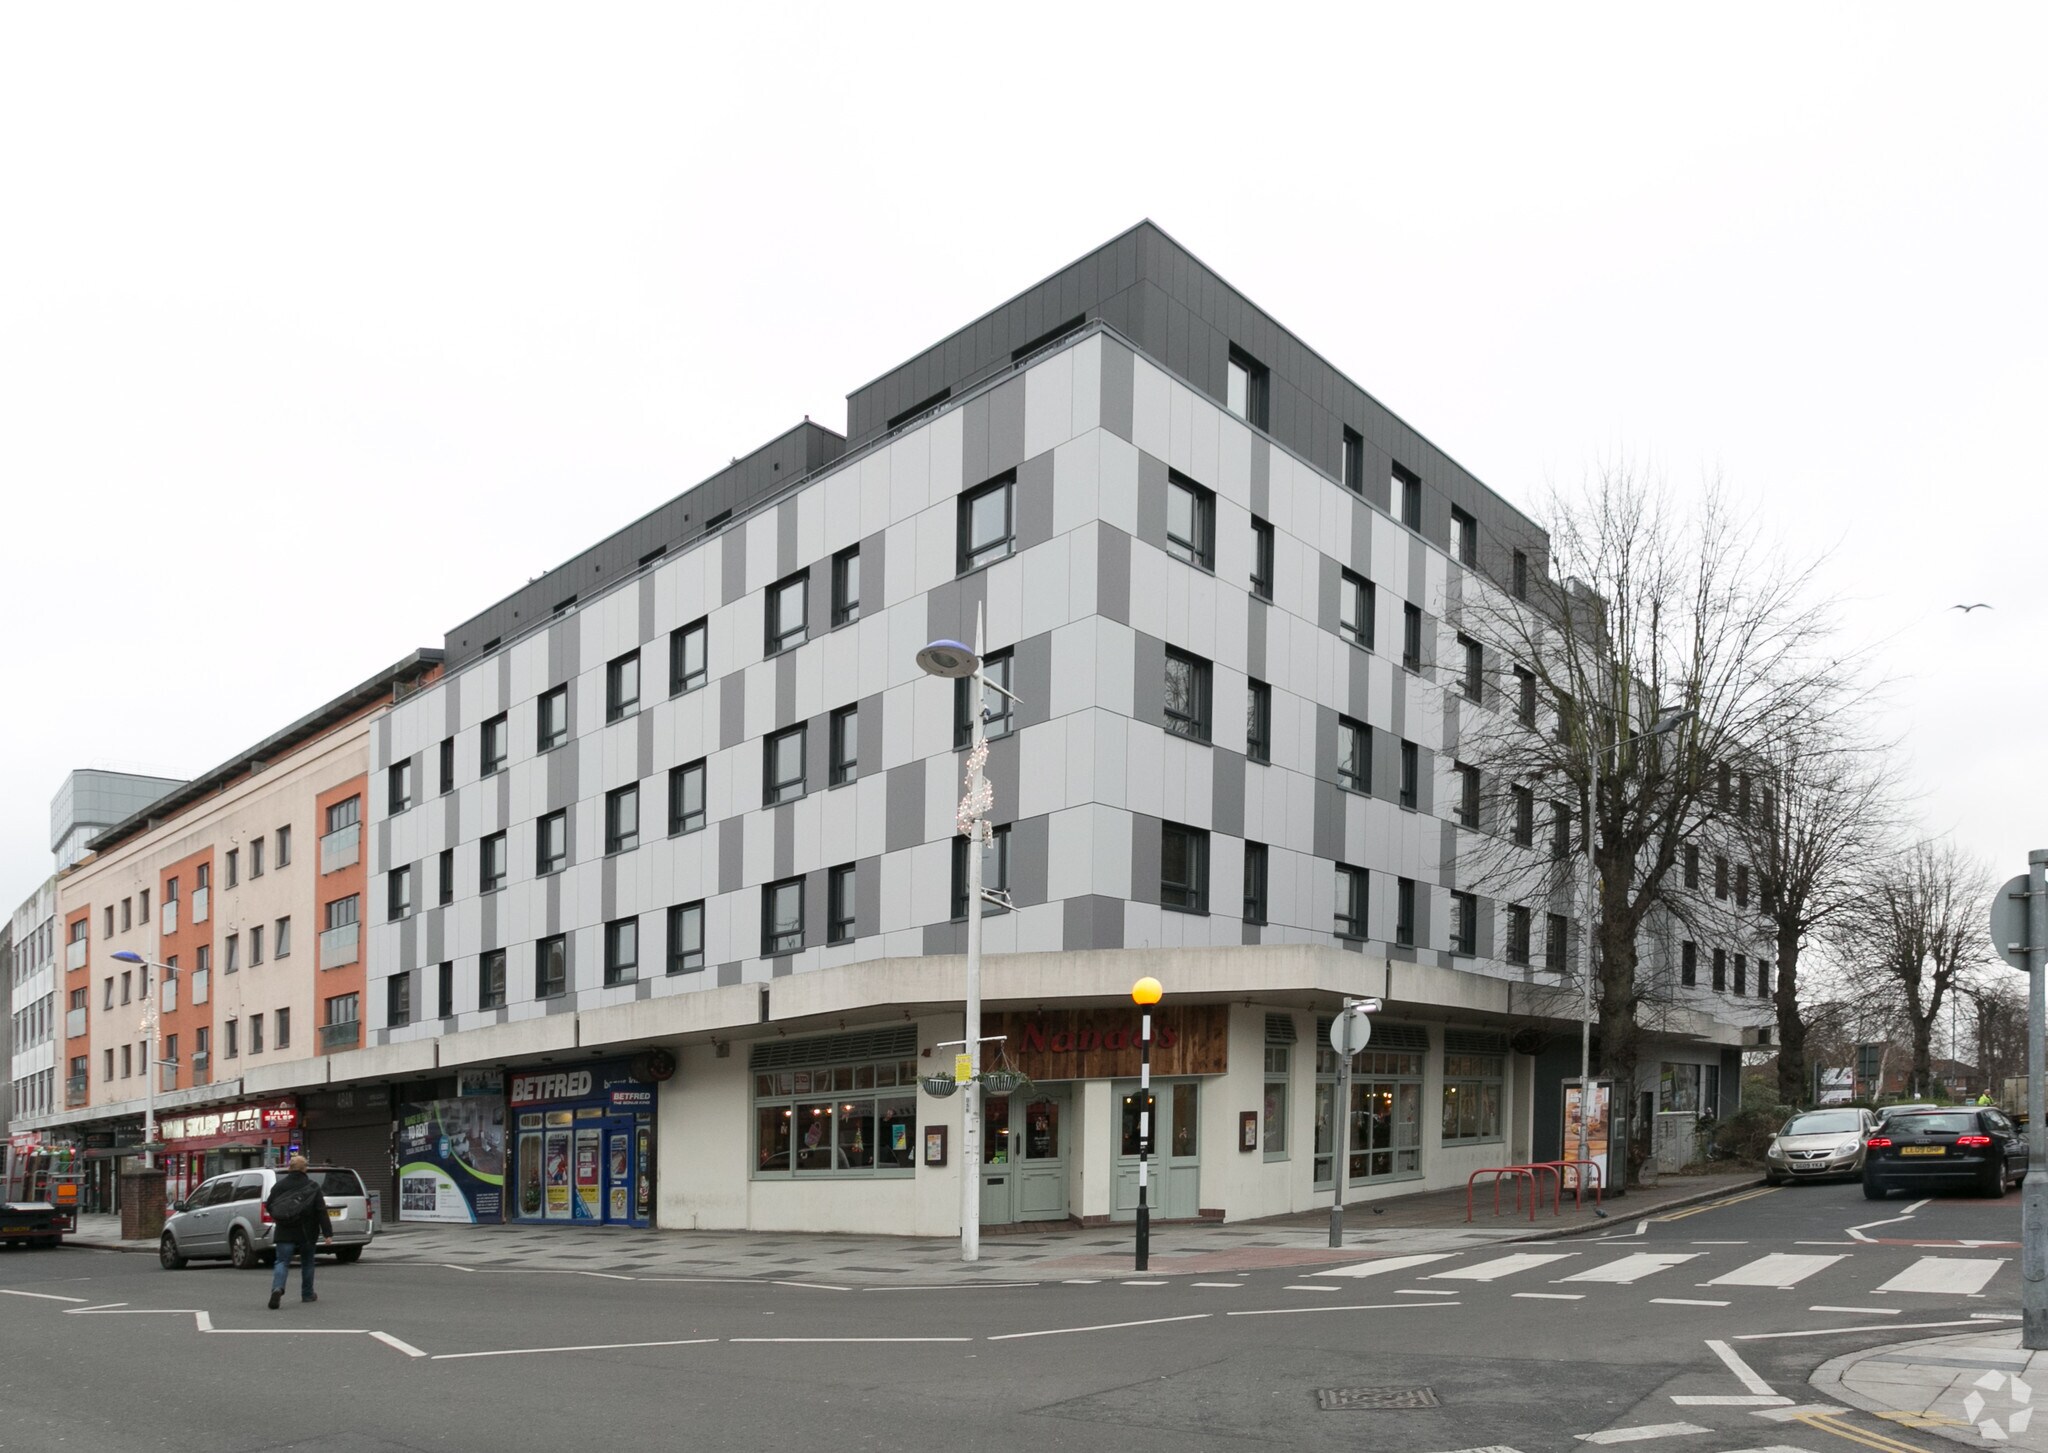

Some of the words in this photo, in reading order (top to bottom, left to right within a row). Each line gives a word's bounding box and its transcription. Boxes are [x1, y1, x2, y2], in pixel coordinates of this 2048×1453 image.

[1019, 1018, 1179, 1053] Nando's
[511, 1071, 592, 1102] BETFRED
[613, 1092, 651, 1100] BETFRED
[186, 1114, 220, 1137] SKLEP
[222, 1121, 236, 1133] OFF
